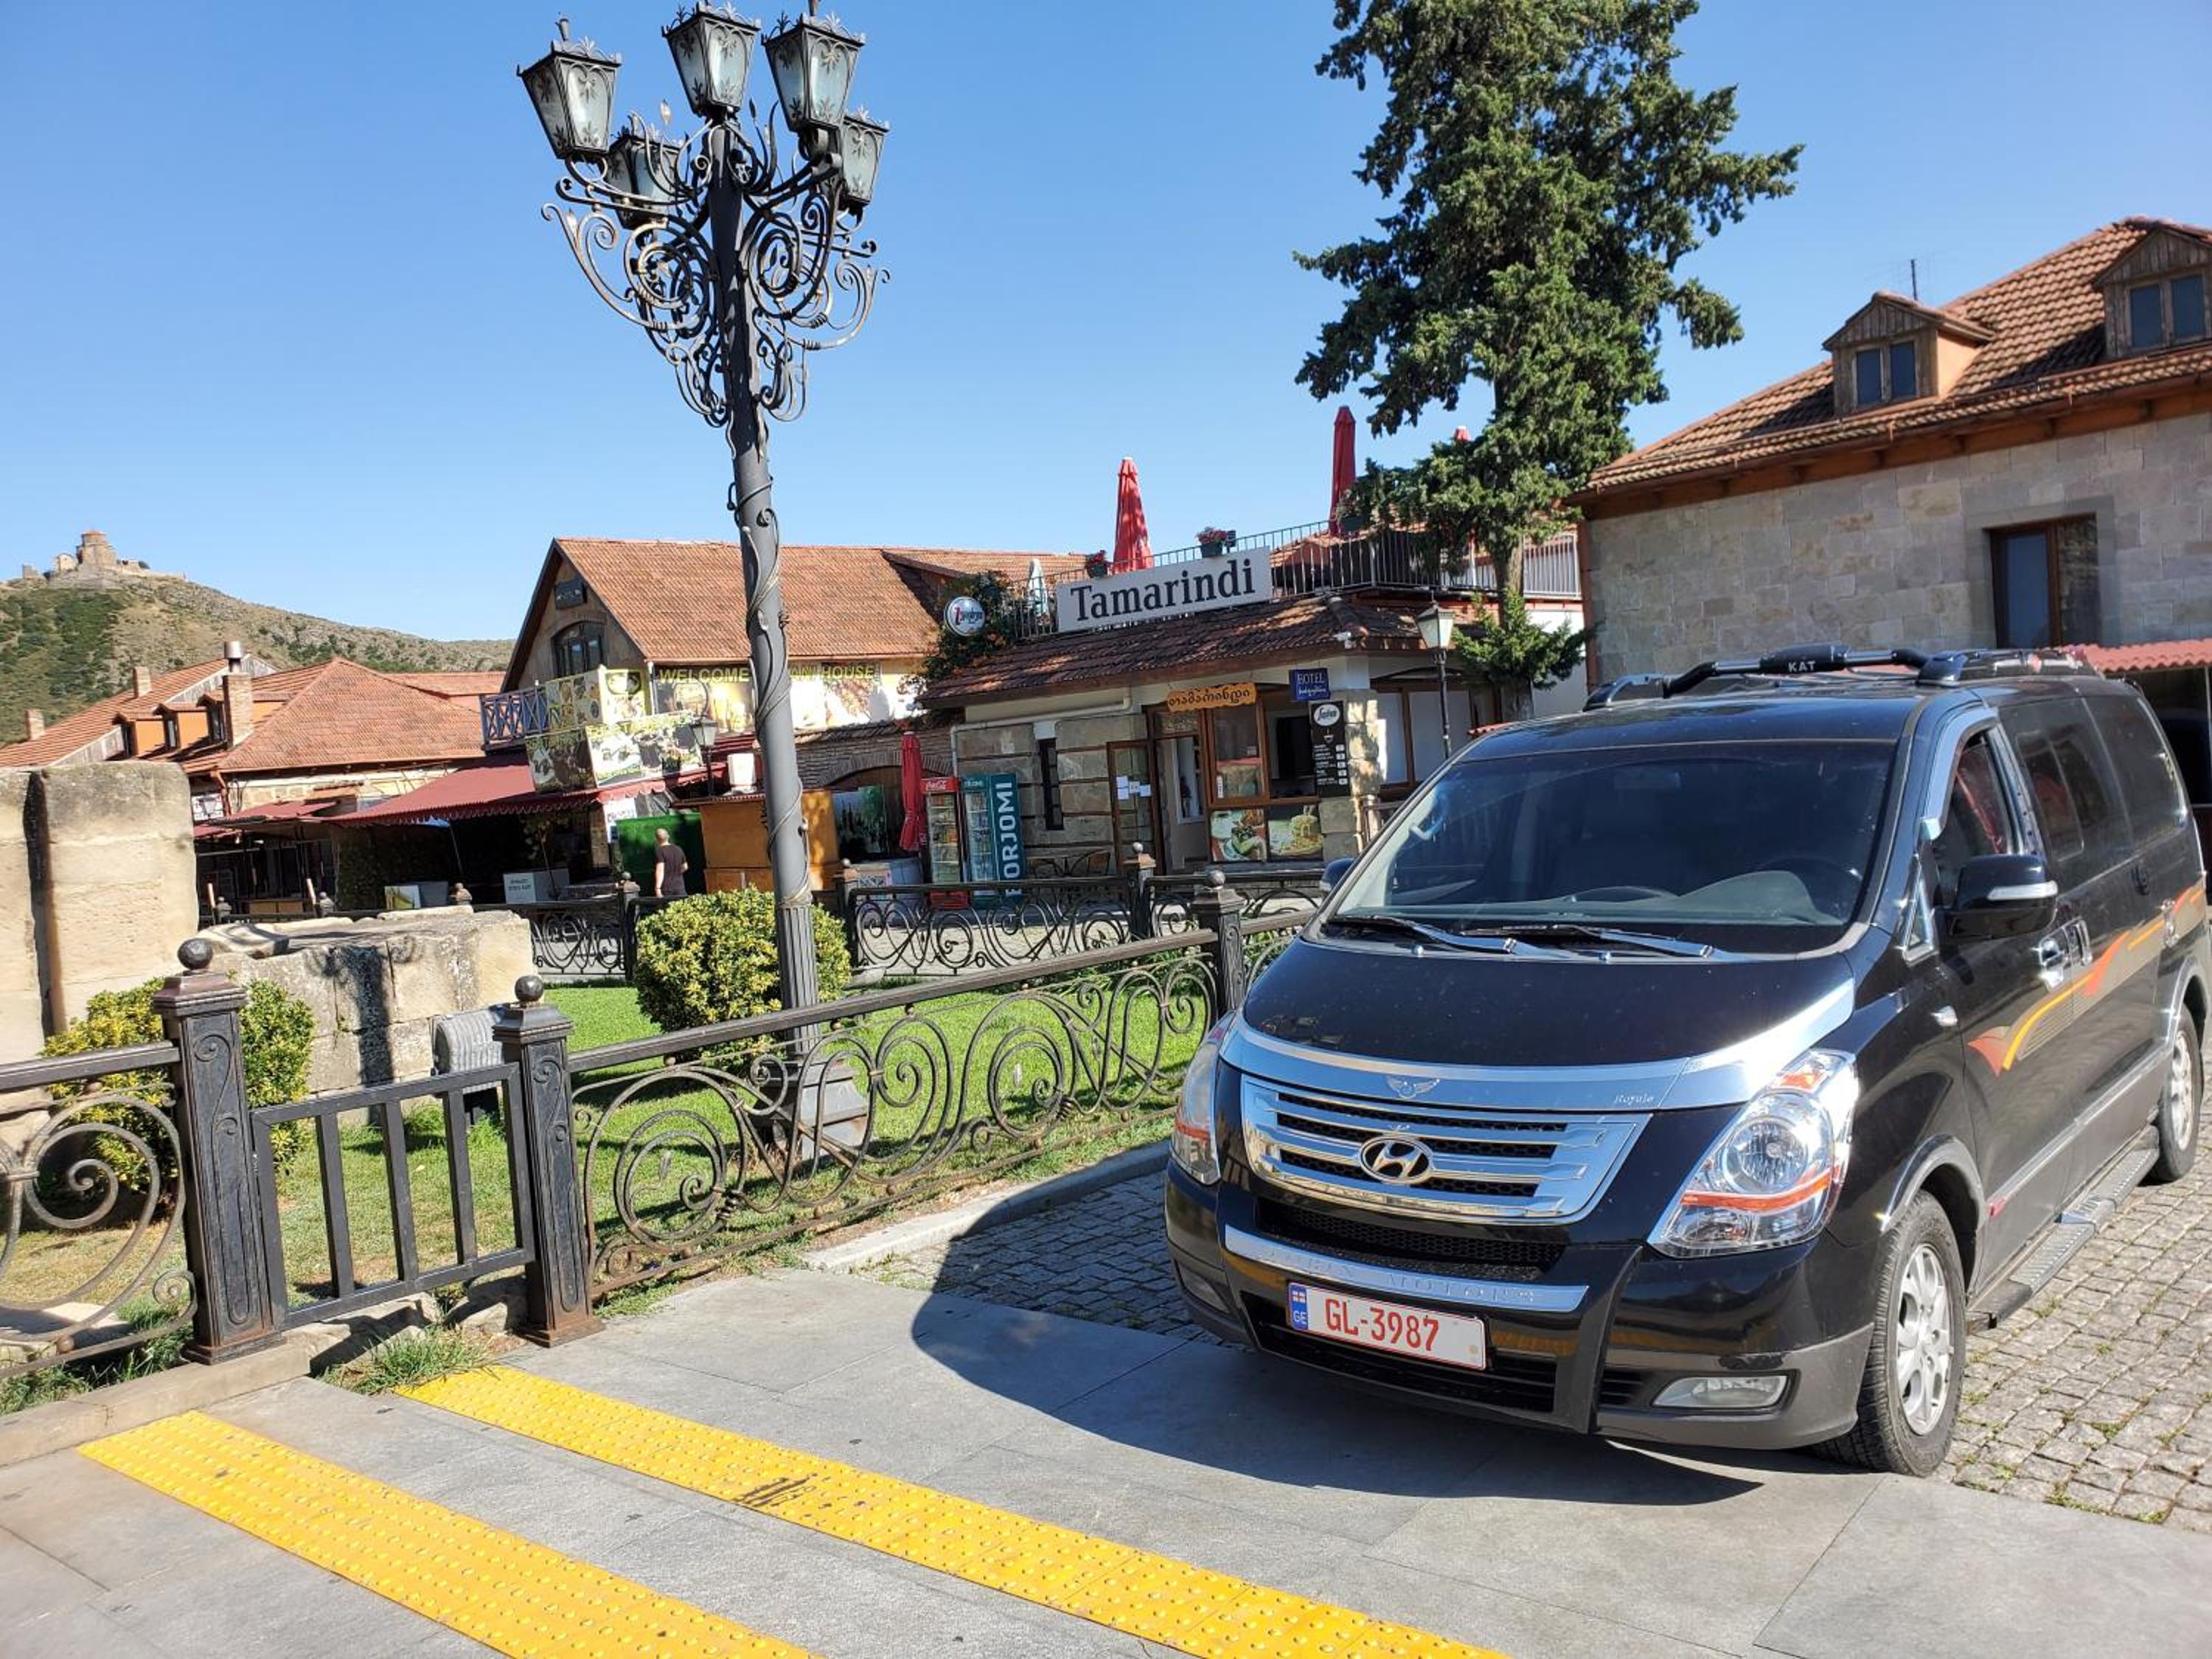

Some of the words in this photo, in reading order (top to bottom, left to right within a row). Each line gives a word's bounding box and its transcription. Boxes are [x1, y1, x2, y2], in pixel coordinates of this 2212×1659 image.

[1071, 558, 1255, 621] Tamarindi
[659, 667, 750, 684] WELCOME
[822, 665, 874, 679] HOUSE
[1788, 661, 1816, 672] KAT
[1293, 1310, 1307, 1325] GE
[1325, 1298, 1440, 1352] GL-3987
